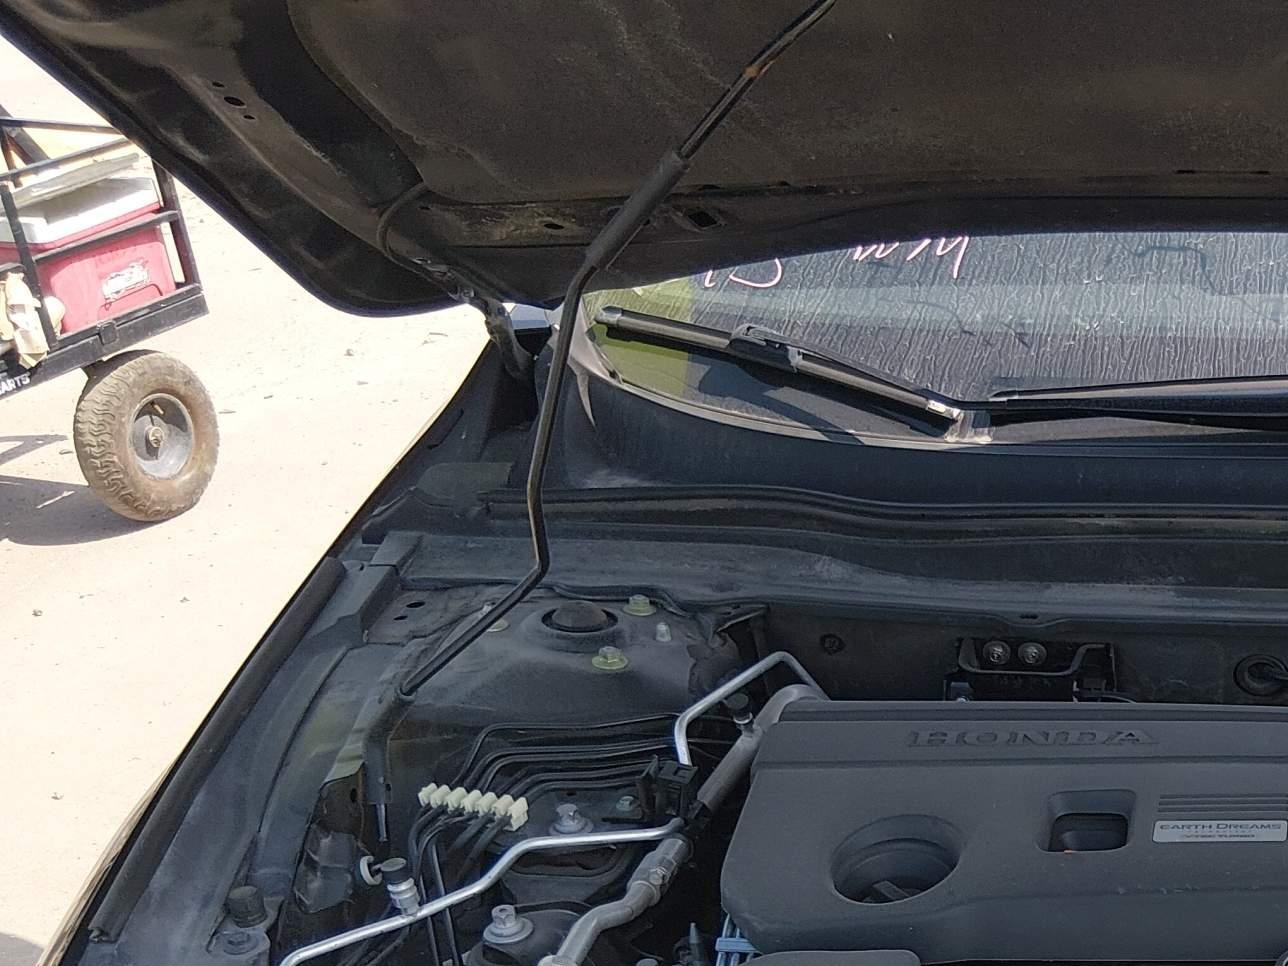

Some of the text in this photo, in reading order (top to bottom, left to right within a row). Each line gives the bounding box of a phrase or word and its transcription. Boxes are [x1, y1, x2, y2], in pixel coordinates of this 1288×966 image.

[0, 371, 30, 395] ARTS
[907, 731, 1160, 747] HONDA
[1216, 822, 1281, 830] DREAMS
